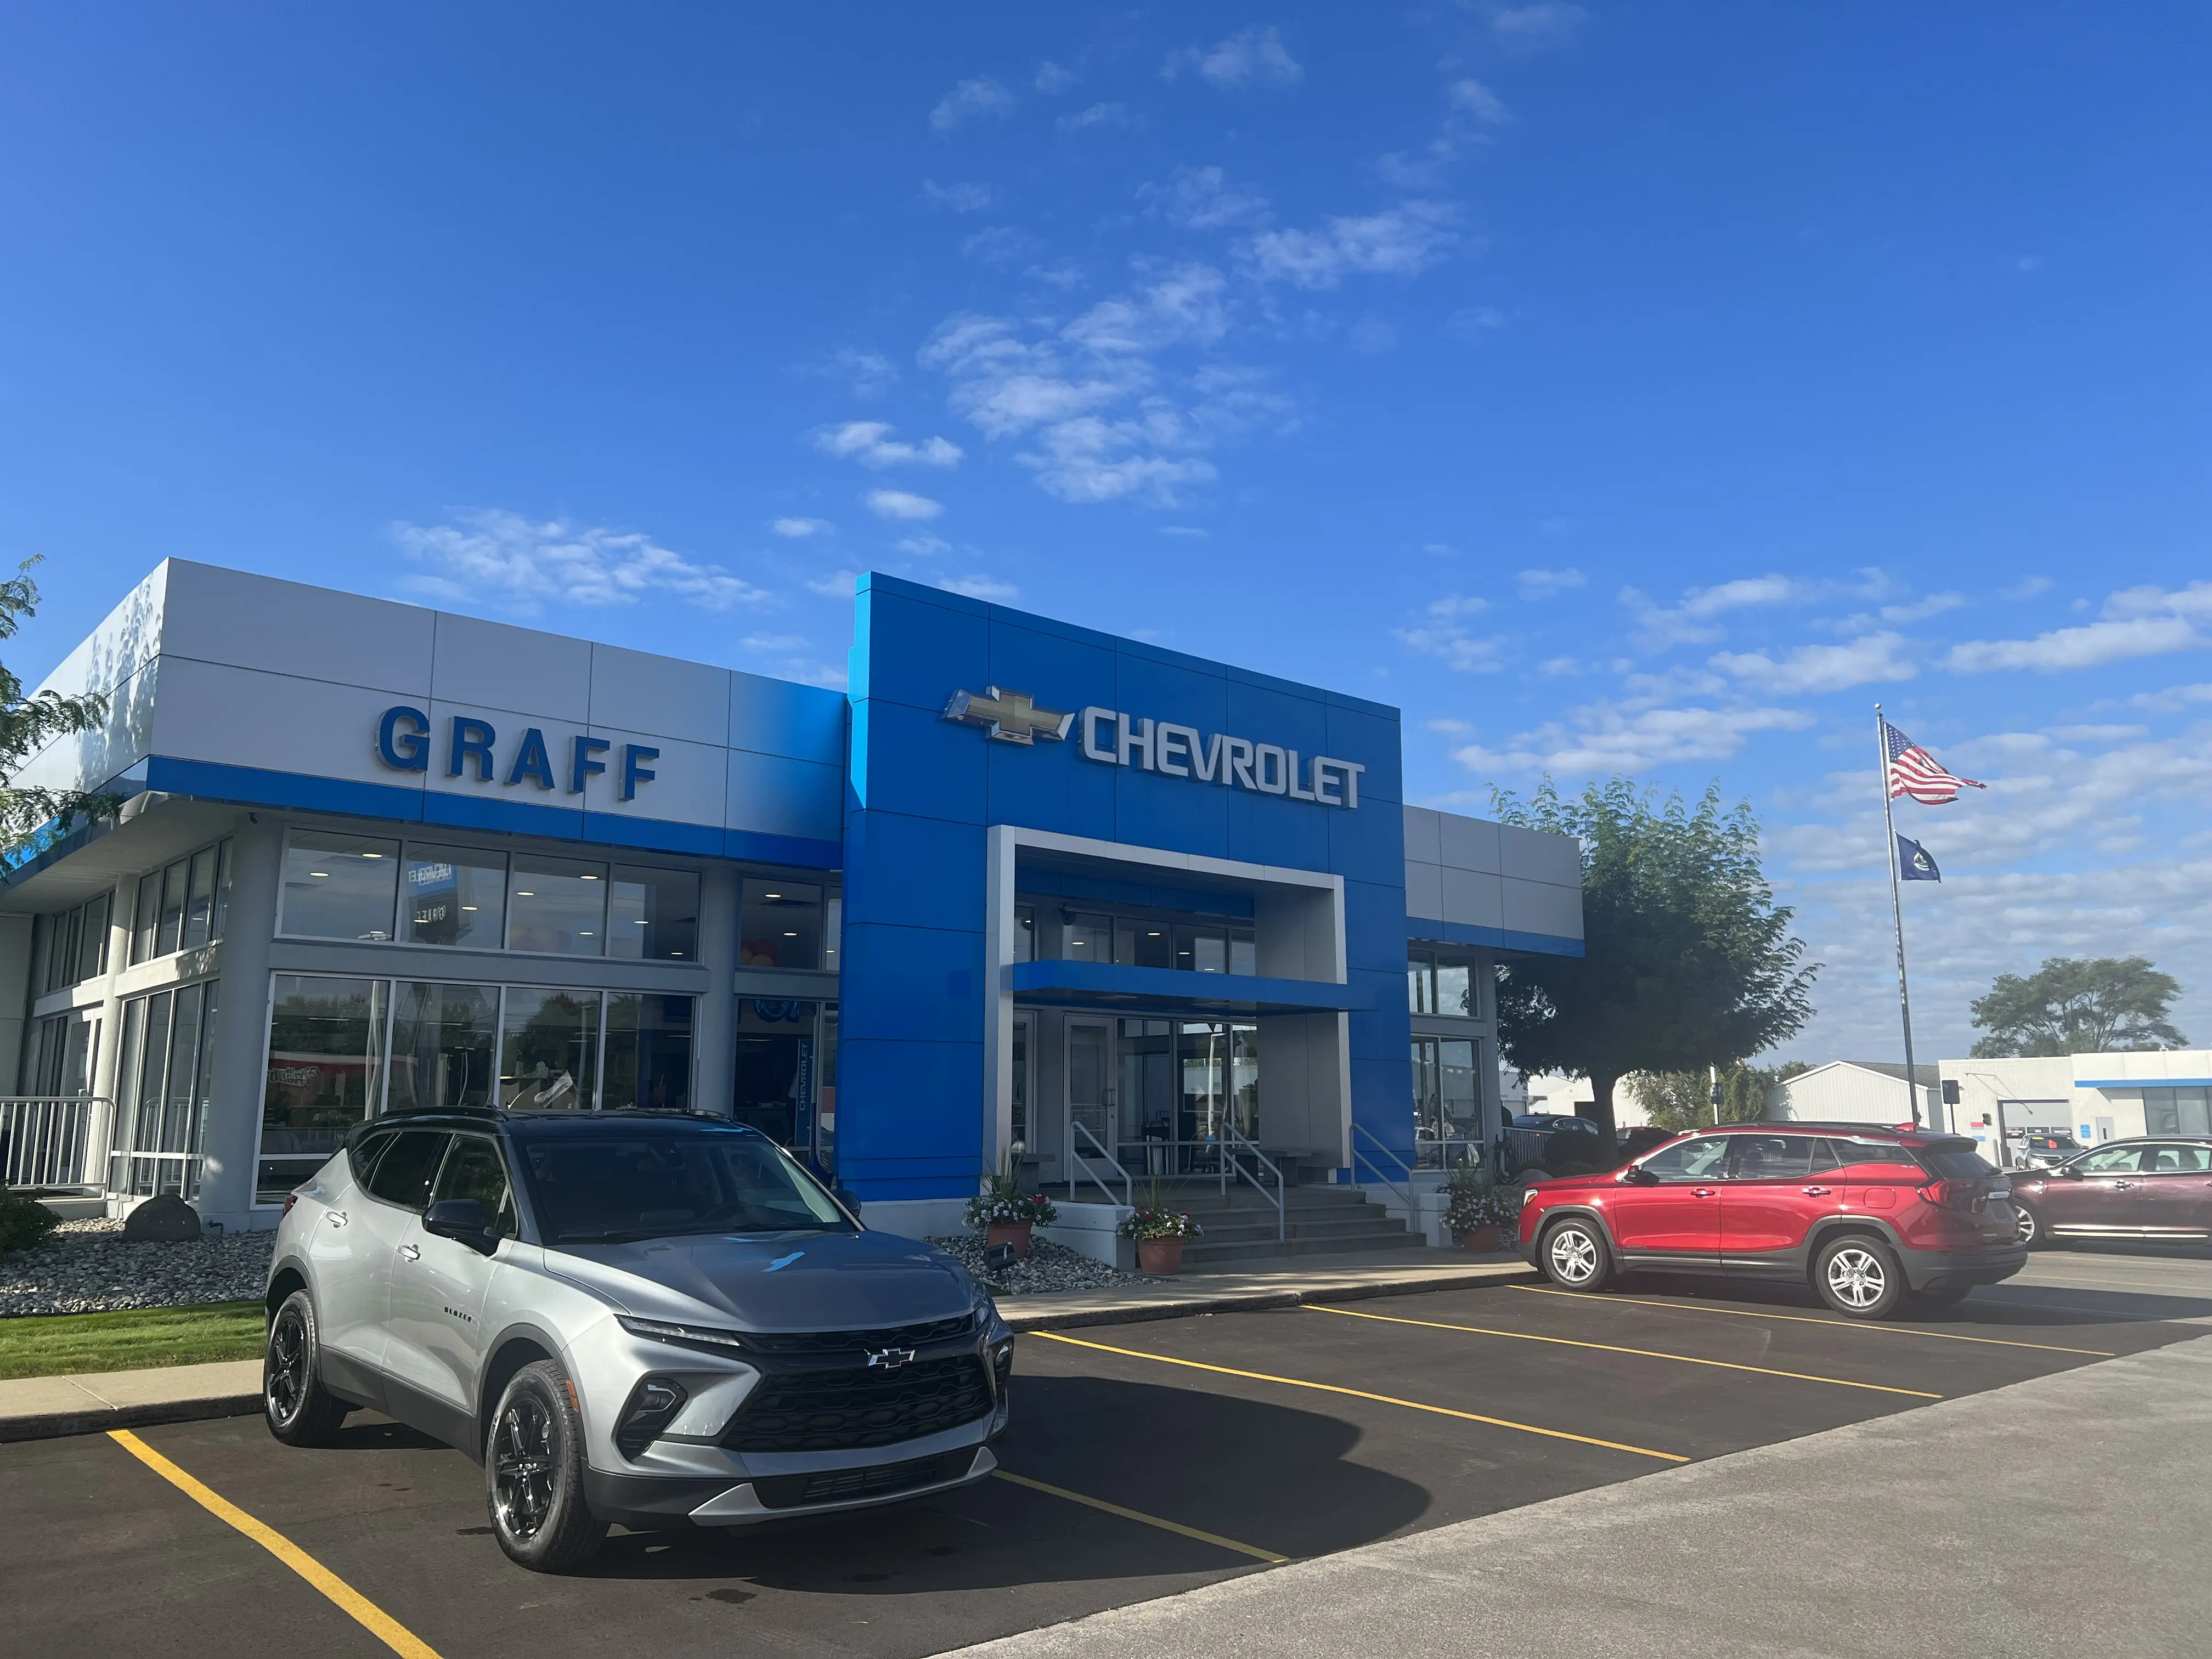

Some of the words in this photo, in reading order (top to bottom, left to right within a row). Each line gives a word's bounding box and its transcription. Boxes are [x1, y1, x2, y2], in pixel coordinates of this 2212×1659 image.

[374, 706, 660, 802] GRAFF
[1079, 706, 1365, 810] CHEVROLET
[799, 1043, 808, 1111] CHEVROLET
[444, 1307, 472, 1323] BLAZER
